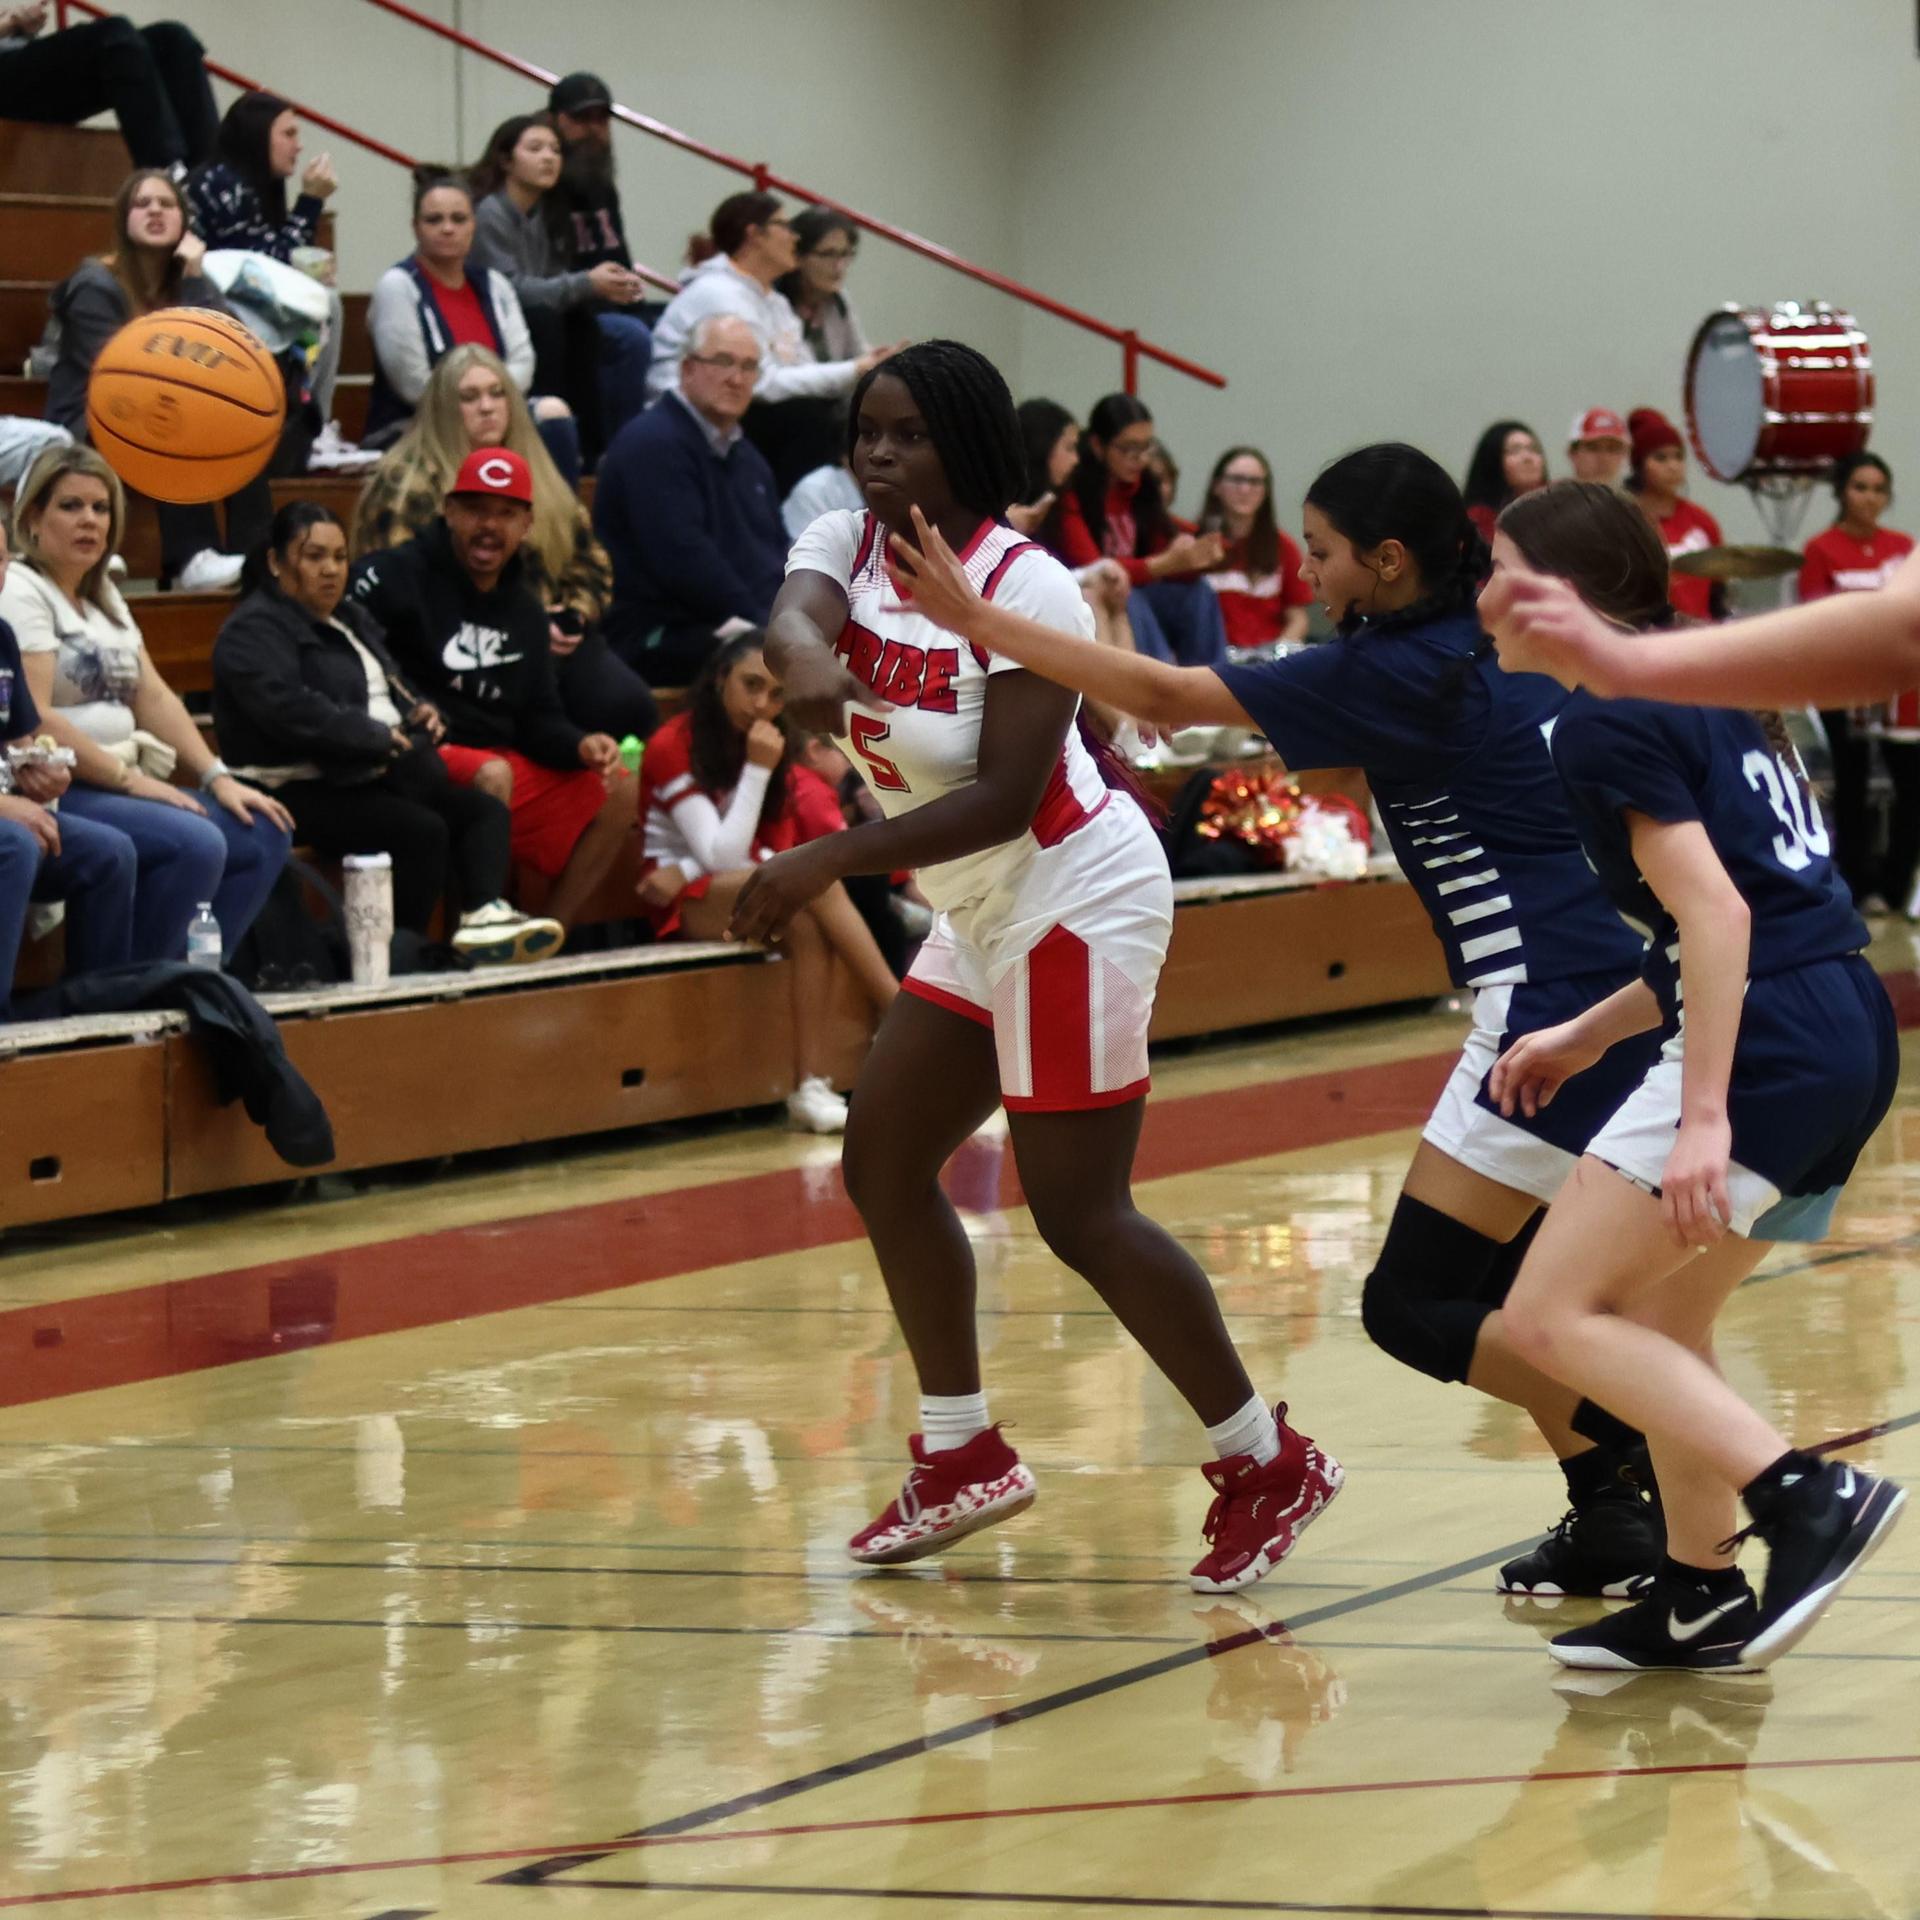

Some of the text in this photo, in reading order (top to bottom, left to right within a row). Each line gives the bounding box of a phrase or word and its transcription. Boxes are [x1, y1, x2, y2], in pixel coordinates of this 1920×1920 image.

[478, 457, 513, 488] C
[850, 711, 912, 794] 5
[1742, 744, 1831, 872] 30
